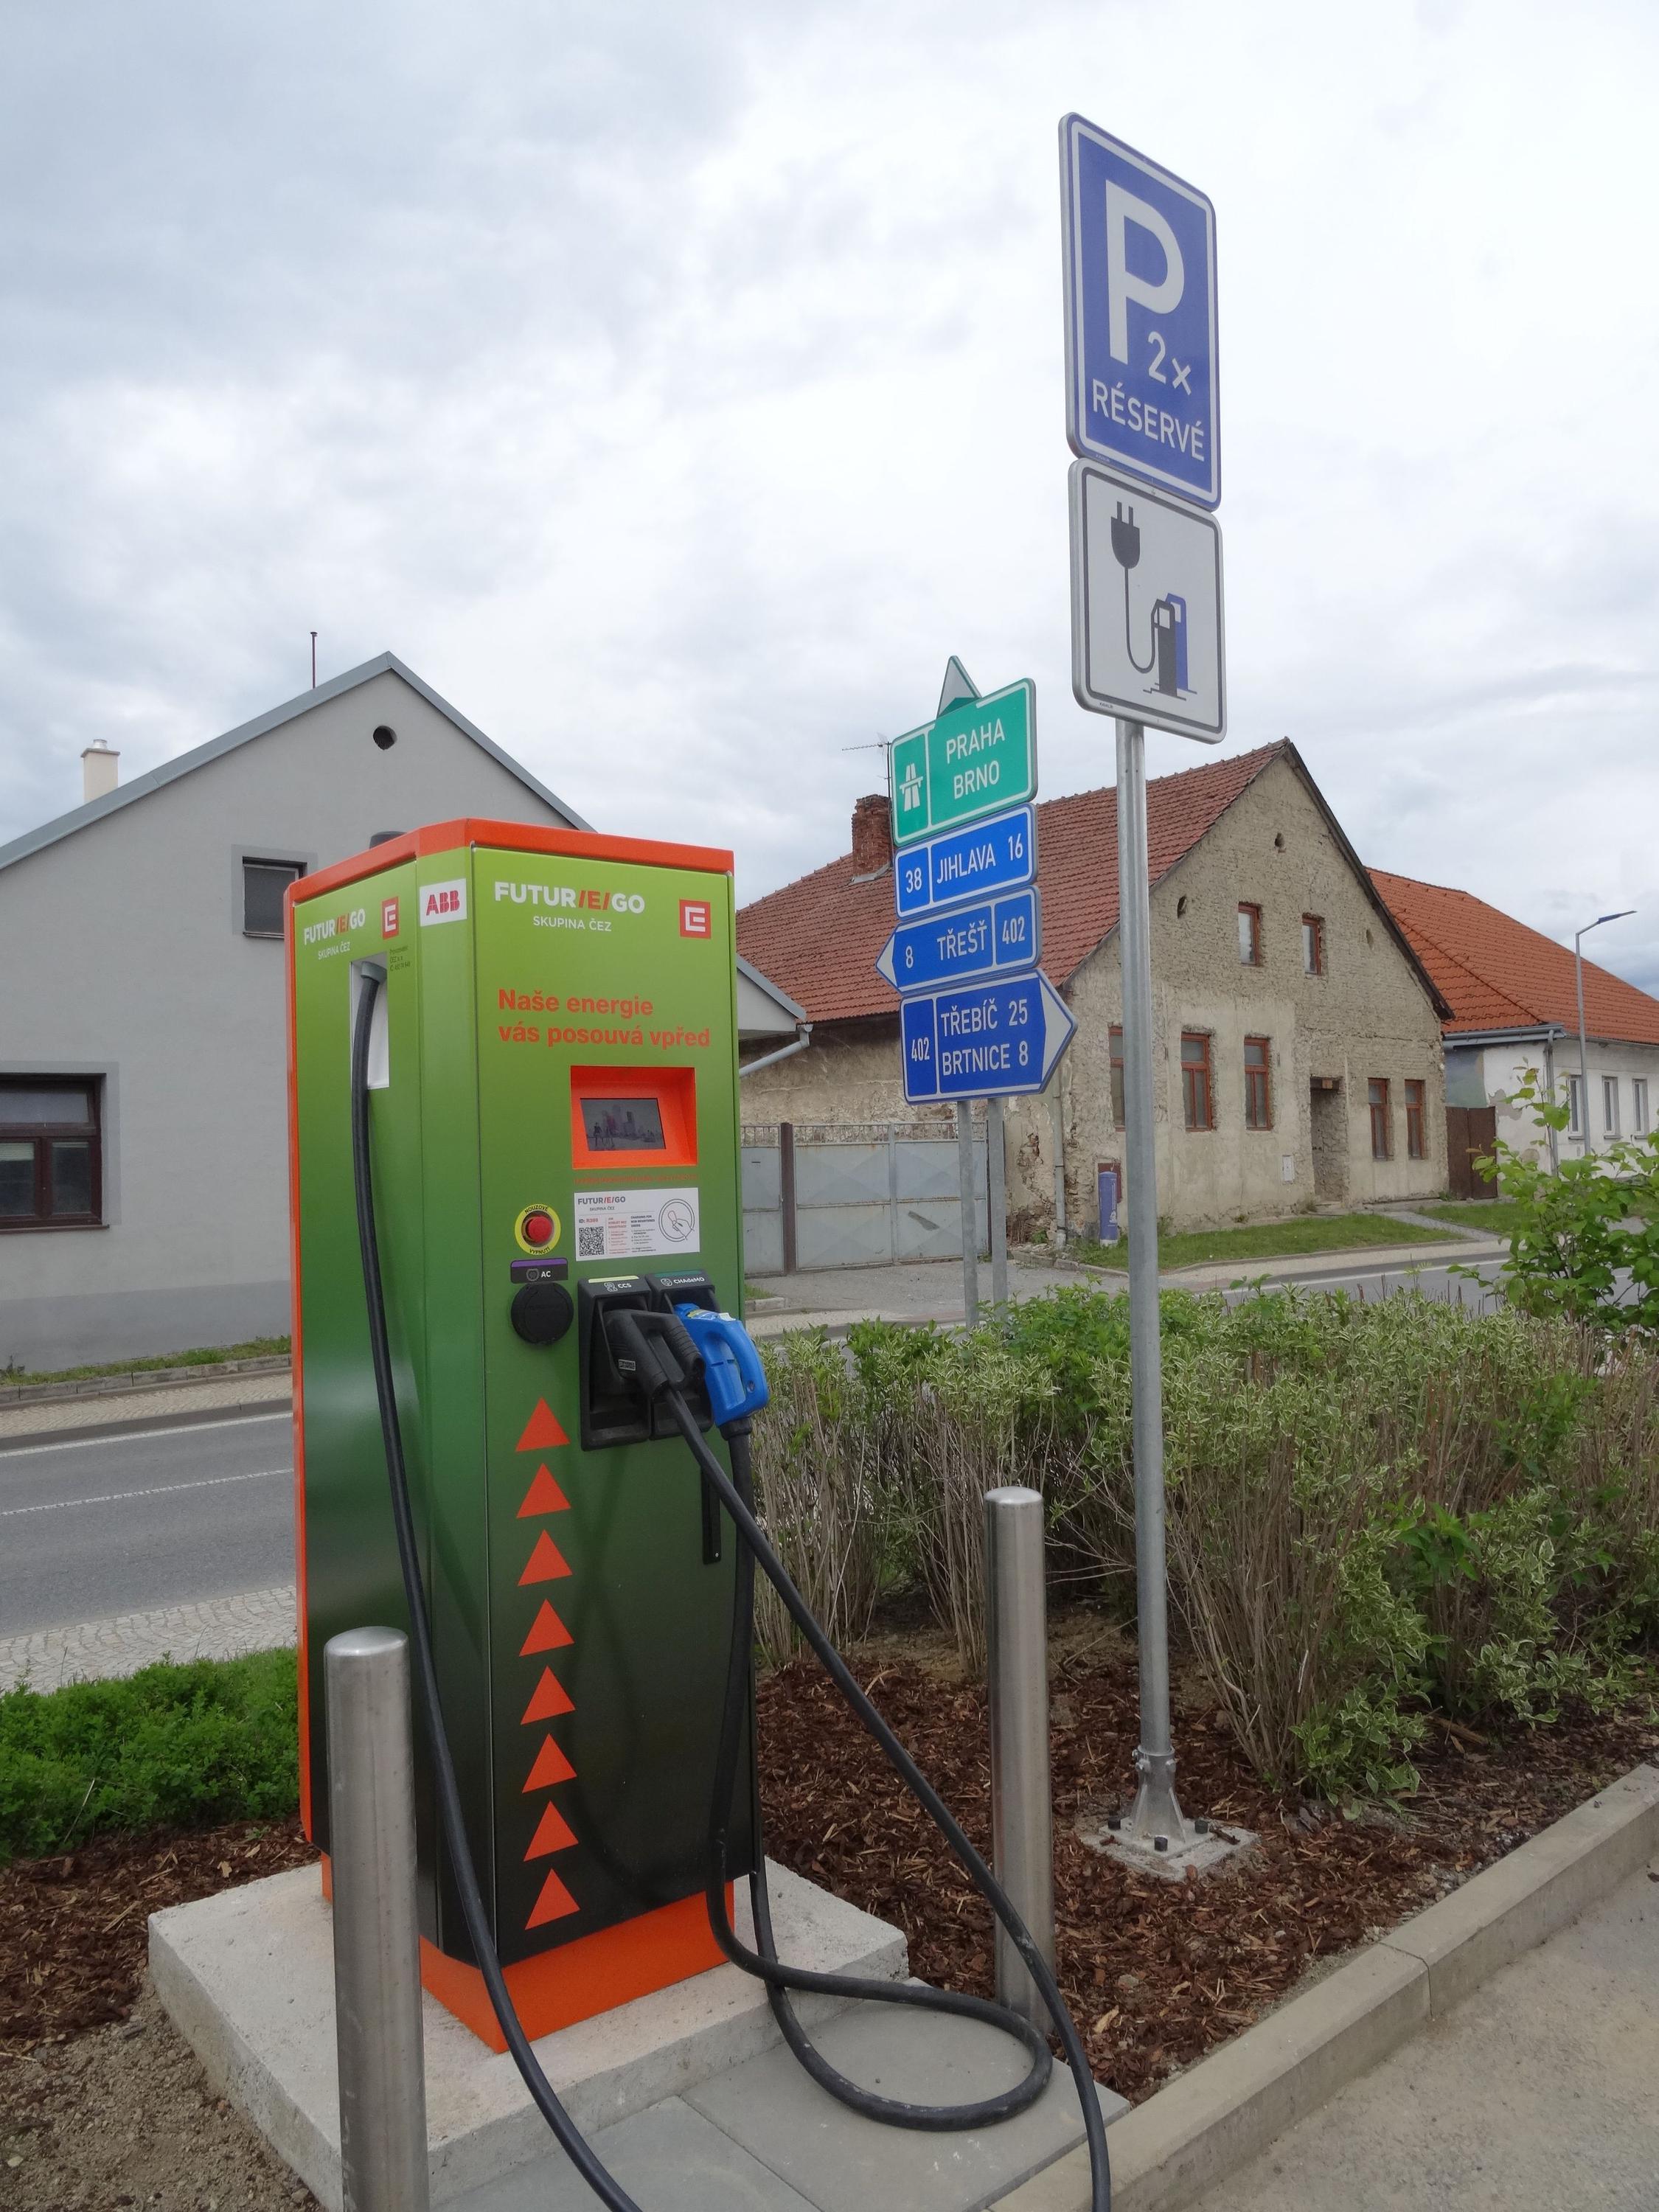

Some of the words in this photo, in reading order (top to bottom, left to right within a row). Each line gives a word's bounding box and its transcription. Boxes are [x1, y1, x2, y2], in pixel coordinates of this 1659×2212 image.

[1105, 178, 1185, 365] P
[1147, 331, 1192, 396] 2x
[1092, 378, 1205, 462] RÉSERVÉ
[946, 718, 1006, 764] PRAHA
[953, 760, 1000, 800] BRNO
[905, 867, 922, 894] 38
[936, 843, 996, 884] JIHLAVA
[1008, 832, 1023, 861] 16
[425, 890, 460, 917] ABB
[494, 881, 645, 914] FUTUR/E/GO
[304, 908, 366, 945] FUTUR/E/GO
[532, 915, 585, 930] SKUPINA
[588, 918, 612, 932] ČEZ
[318, 945, 339, 960] SKUPINA
[340, 941, 351, 953] ČEZ
[905, 945, 914, 968] 8
[936, 919, 987, 961] TŘEŠŤ
[1002, 916, 1026, 945] 402
[498, 989, 560, 1012] Naše
[566, 993, 653, 1020] energie
[940, 998, 998, 1037] TŘEBÍČ
[1009, 998, 1028, 1026] 25
[498, 1021, 540, 1043] vás
[547, 1025, 644, 1048] posouvá
[649, 1026, 710, 1051] vpřed
[911, 1037, 930, 1062] 402
[942, 1043, 1011, 1076] BRTNICE
[1018, 1040, 1029, 1066] 8
[577, 1195, 626, 1206] FUTUR/E/GO
[673, 1276, 705, 1284] CHAdeMO
